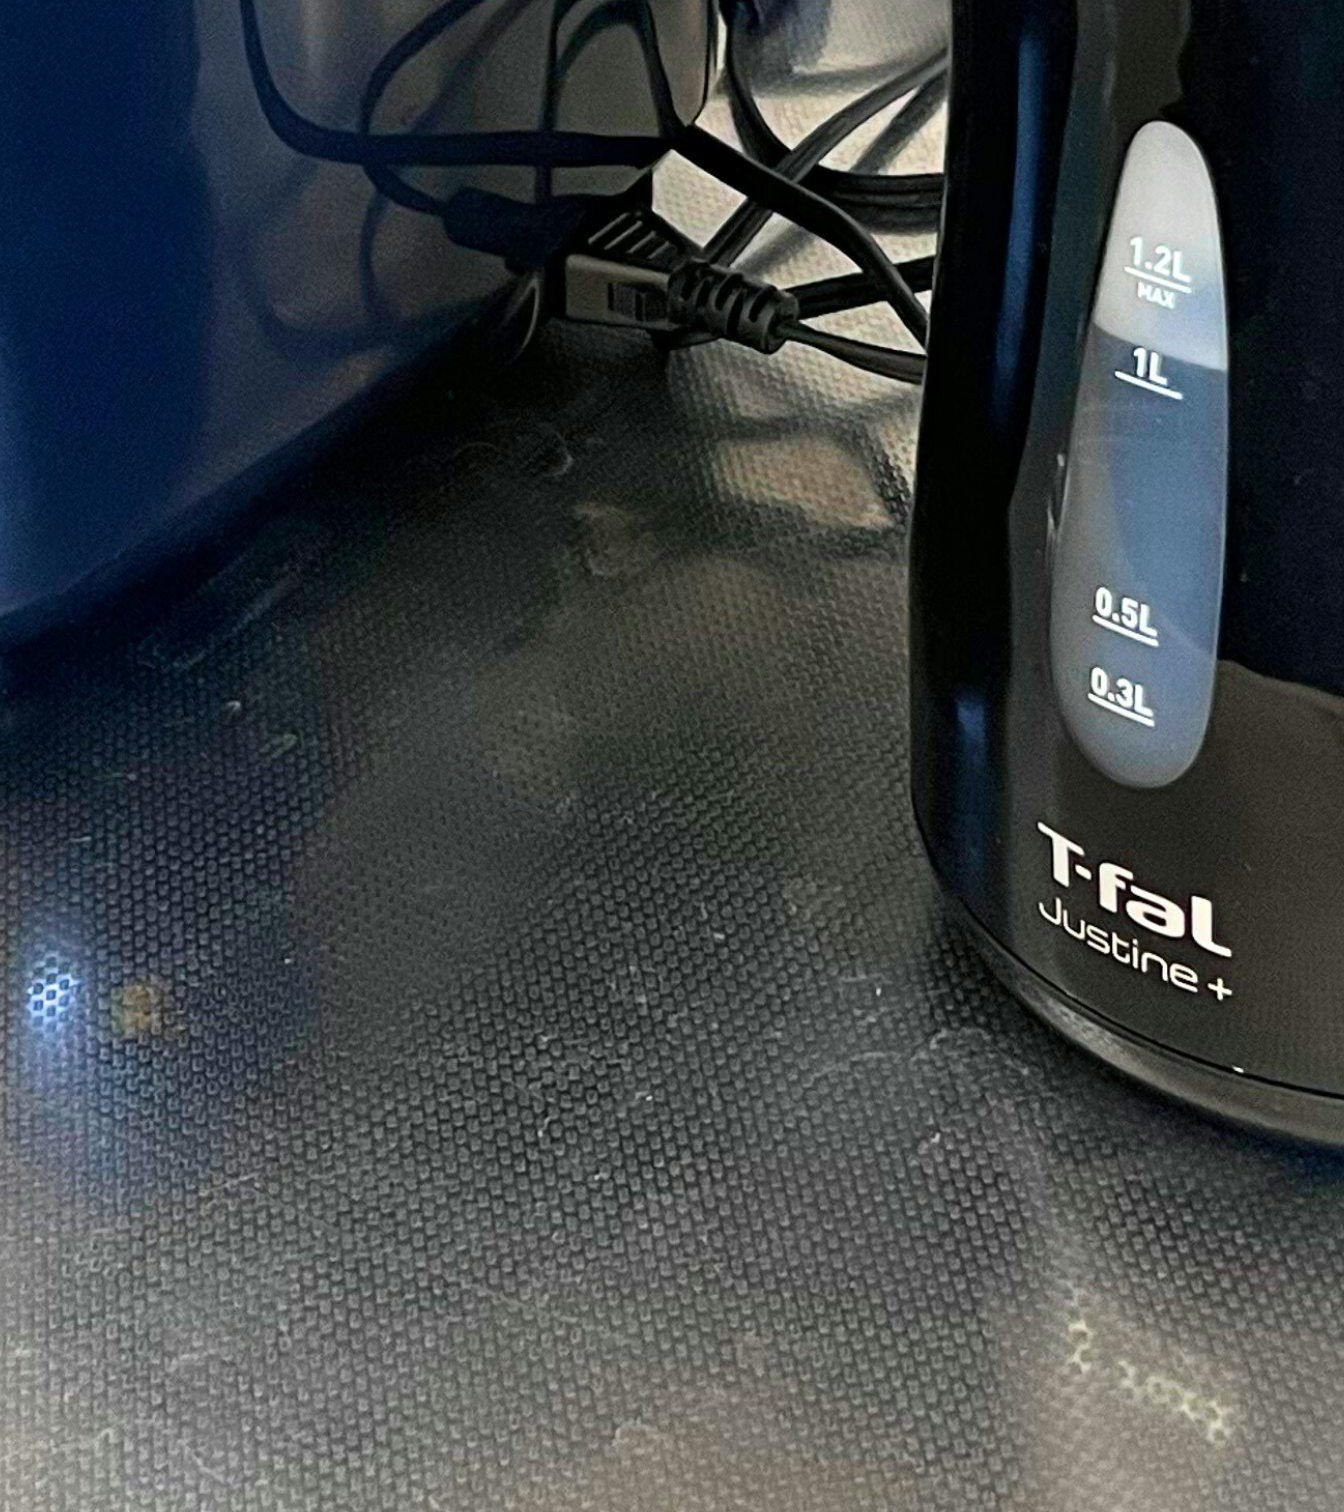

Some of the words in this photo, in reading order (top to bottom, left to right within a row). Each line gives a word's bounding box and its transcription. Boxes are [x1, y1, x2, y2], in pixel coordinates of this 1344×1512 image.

[1128, 236, 1193, 284] 1.2L
[1136, 282, 1176, 310] MAX
[1132, 346, 1169, 386] 1L
[1095, 586, 1158, 638] 0.5L
[1090, 666, 1154, 718] 0.3L
[1036, 821, 1233, 958] T-fal
[1038, 896, 1200, 994] Justine
